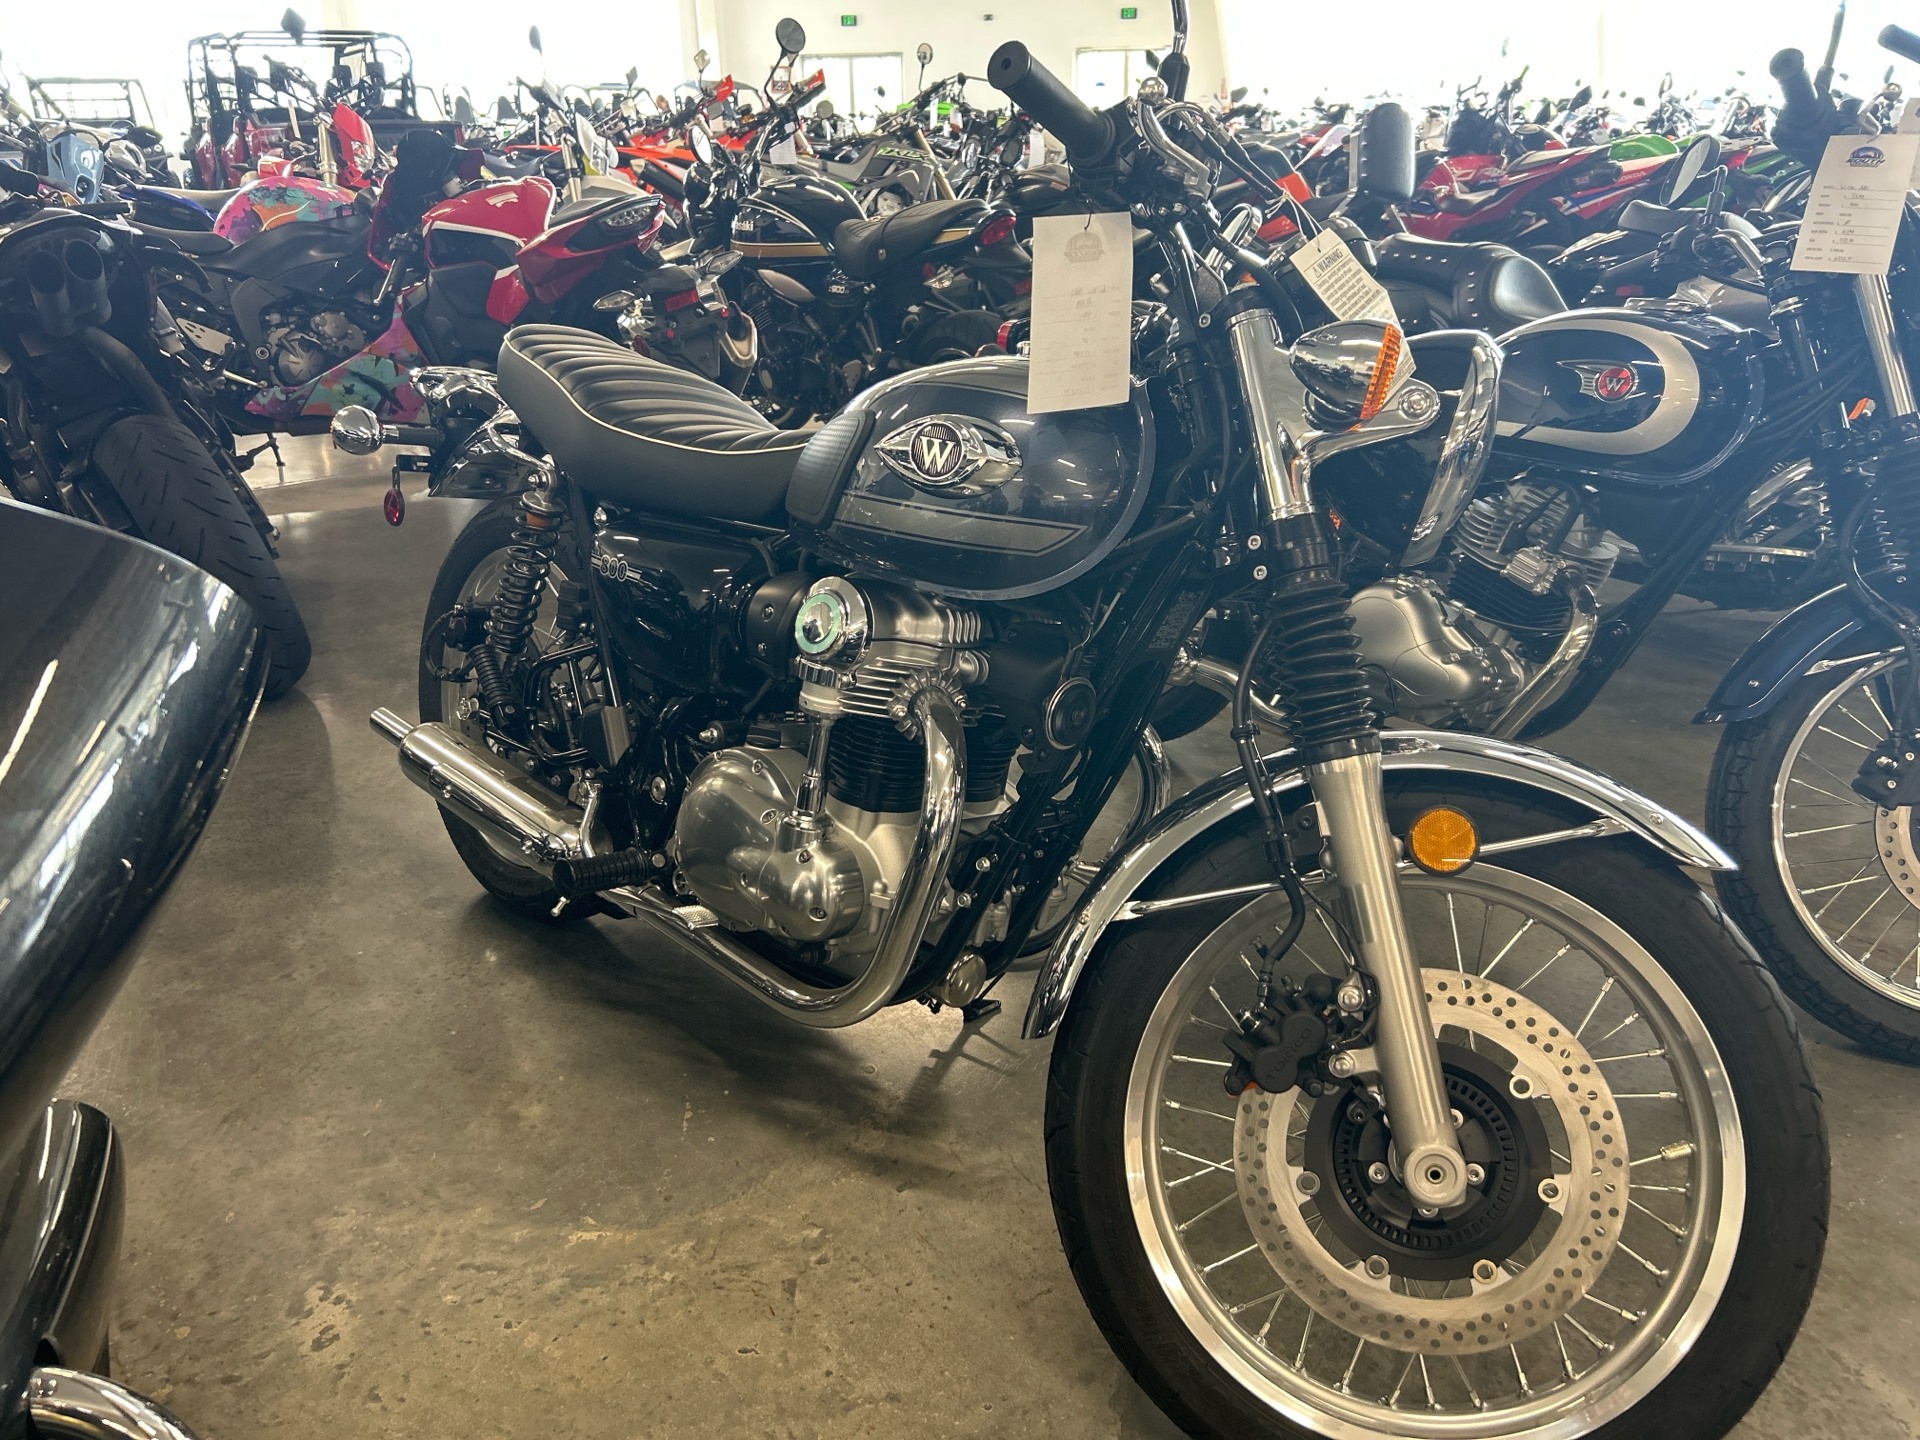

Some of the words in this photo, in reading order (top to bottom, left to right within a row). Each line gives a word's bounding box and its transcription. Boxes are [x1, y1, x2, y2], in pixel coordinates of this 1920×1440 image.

[1317, 248, 1343, 274] WARNING
[1605, 377, 1626, 392] W
[919, 435, 957, 473] W
[600, 554, 629, 582] 800
